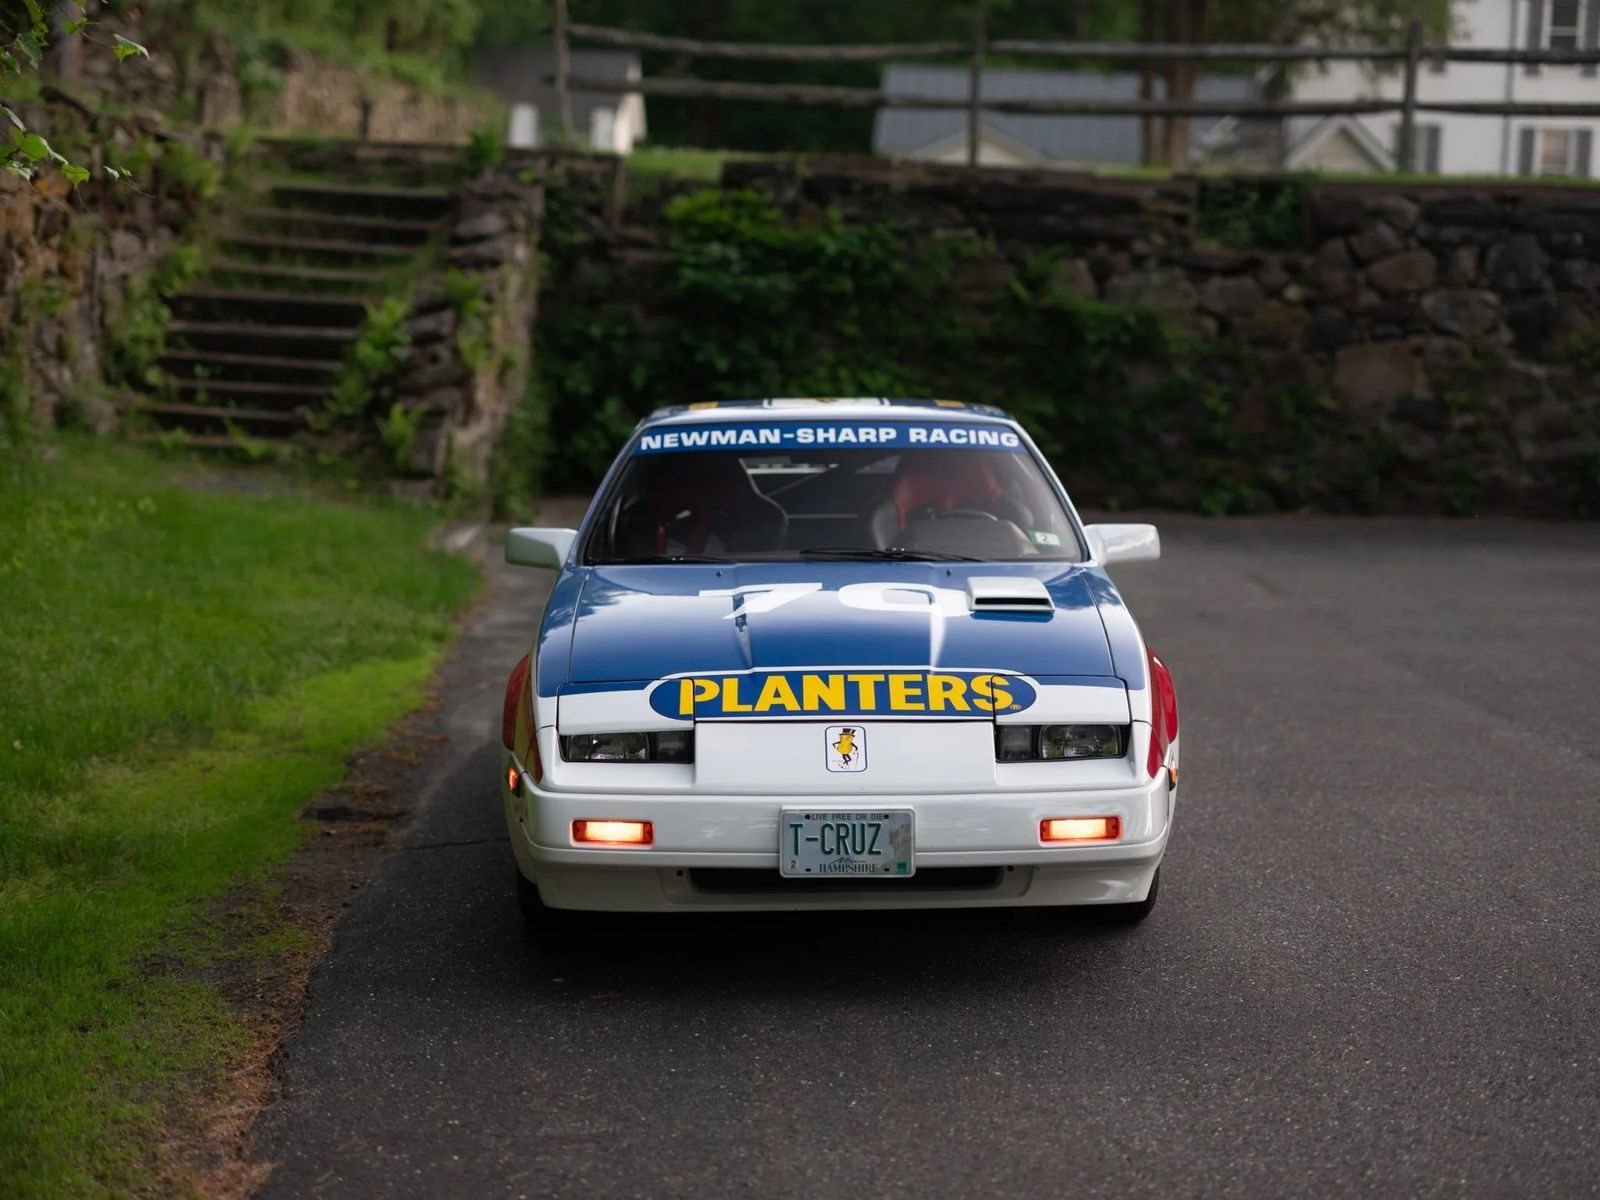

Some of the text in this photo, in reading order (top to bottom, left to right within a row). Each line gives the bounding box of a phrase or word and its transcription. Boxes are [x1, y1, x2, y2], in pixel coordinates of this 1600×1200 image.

[641, 427, 1020, 450] NEWMAN-SHARP RACING
[678, 673, 1015, 716] PLANTERS
[811, 813, 884, 821] LIVE FREE OR DIE
[789, 822, 882, 856] T-CRUZ
[819, 863, 879, 874] HAMPSHIRE
